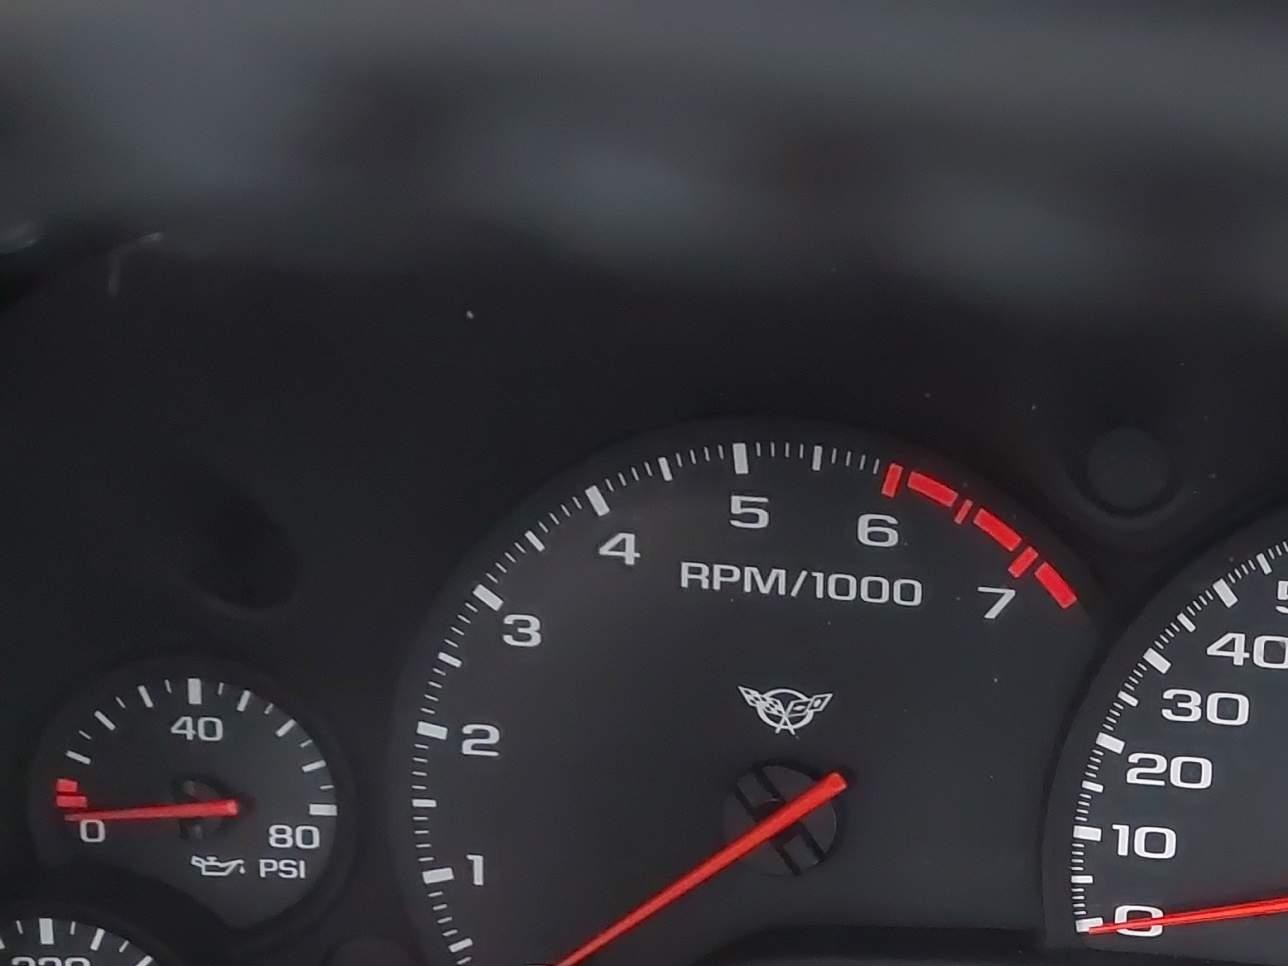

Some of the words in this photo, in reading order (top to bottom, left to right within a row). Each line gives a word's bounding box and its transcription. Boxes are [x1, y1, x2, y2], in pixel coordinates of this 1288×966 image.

[730, 495, 769, 529] 5
[857, 513, 899, 547] 6
[599, 532, 641, 566] 4
[681, 562, 922, 606] RPM/1000
[977, 586, 1016, 619] 7
[502, 613, 542, 647] 3
[1161, 689, 1250, 726] 30
[170, 716, 224, 742] 40
[462, 724, 500, 757] 2
[1126, 752, 1213, 789] 20
[80, 819, 106, 843] 0
[269, 824, 320, 849] 80
[1112, 824, 1177, 859] 10
[259, 859, 306, 879] PSI
[467, 854, 484, 886] 1
[1114, 905, 1164, 937] 0
